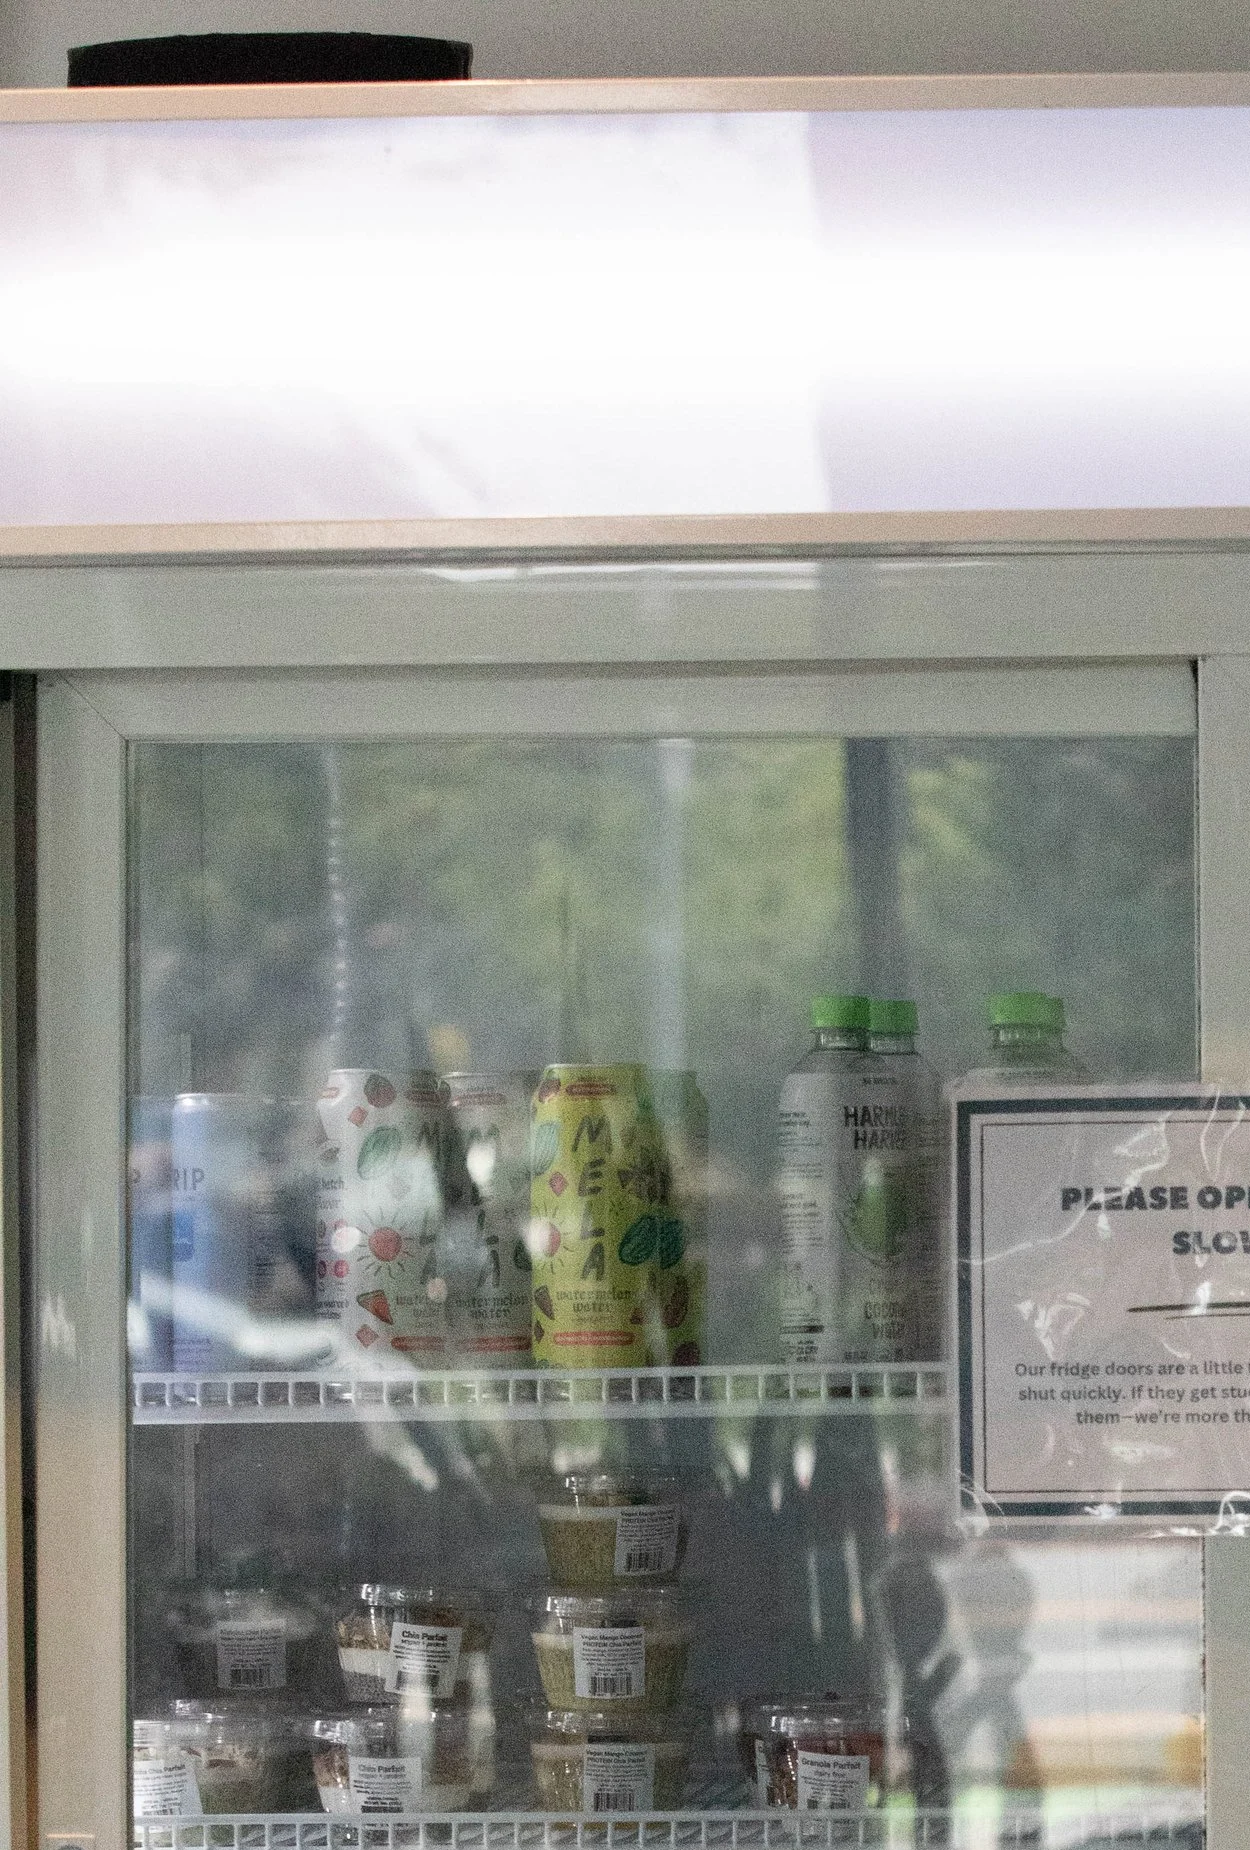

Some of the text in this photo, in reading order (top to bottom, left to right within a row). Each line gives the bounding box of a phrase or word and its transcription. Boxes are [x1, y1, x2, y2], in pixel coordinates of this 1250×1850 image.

[1061, 1187, 1188, 1211] PLEASE
[1015, 1363, 1046, 1376] Our
[1050, 1361, 1100, 1379] fridge
[1105, 1362, 1153, 1375] doors
[1158, 1364, 1185, 1375] are
[1190, 1364, 1199, 1374] a
[1203, 1361, 1243, 1374] little
[1019, 1387, 1055, 1400] shut
[1061, 1386, 1125, 1403] quickly.
[1131, 1386, 1143, 1399] If
[1149, 1386, 1186, 1402] they
[1191, 1387, 1217, 1402] get
[1185, 1412, 1230, 1424] more
[801, 1758, 861, 1770] Granola Parfait
